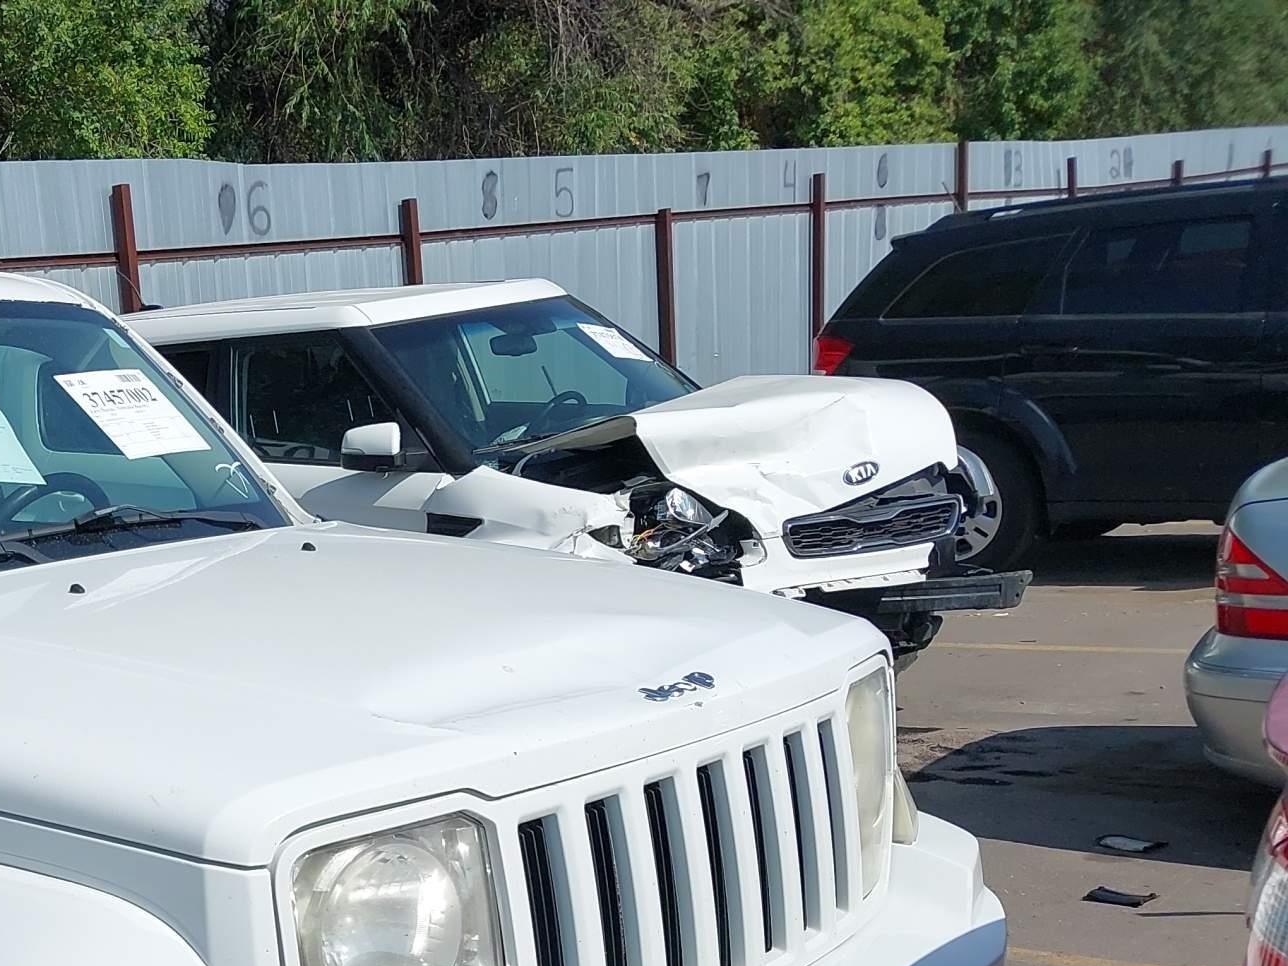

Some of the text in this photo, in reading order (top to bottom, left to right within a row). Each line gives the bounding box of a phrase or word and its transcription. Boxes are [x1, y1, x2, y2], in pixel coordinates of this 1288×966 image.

[555, 167, 574, 217] 5
[83, 386, 158, 408] 37457002
[848, 463, 876, 483] KIA
